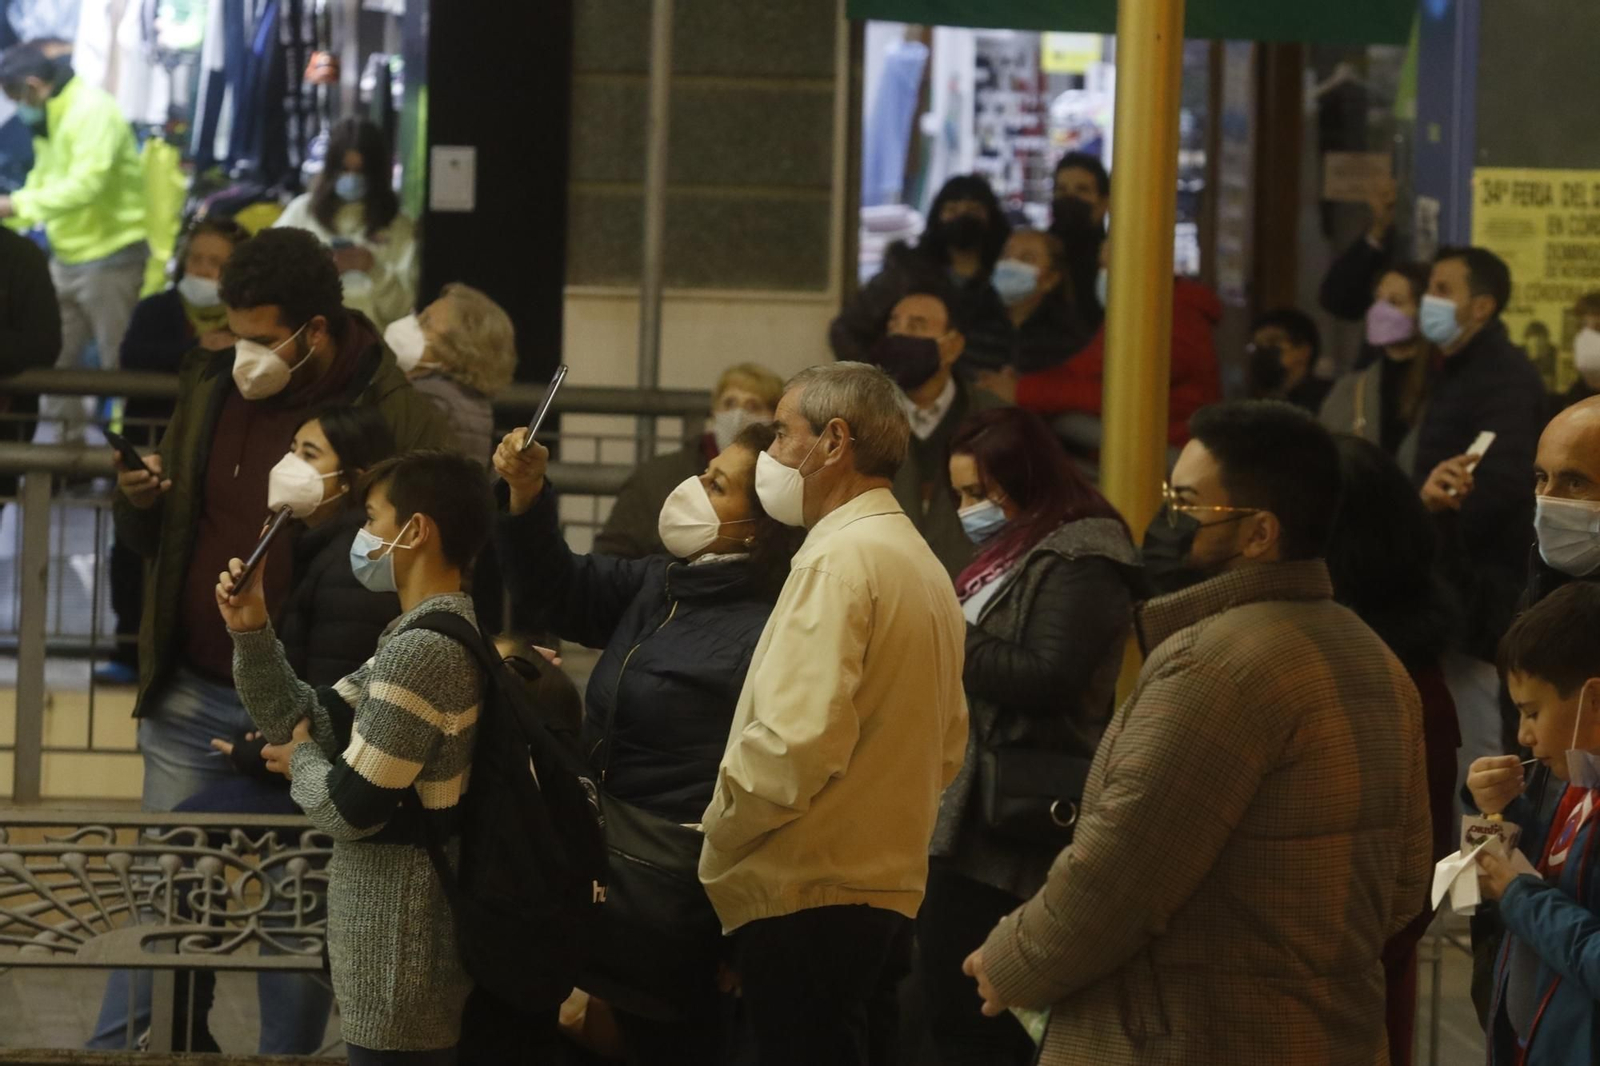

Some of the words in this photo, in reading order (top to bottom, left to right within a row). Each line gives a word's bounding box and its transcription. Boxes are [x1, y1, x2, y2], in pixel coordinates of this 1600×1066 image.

[1510, 180, 1554, 208] FERIA
[1561, 182, 1588, 208] DEL
[1547, 213, 1563, 236] EN
